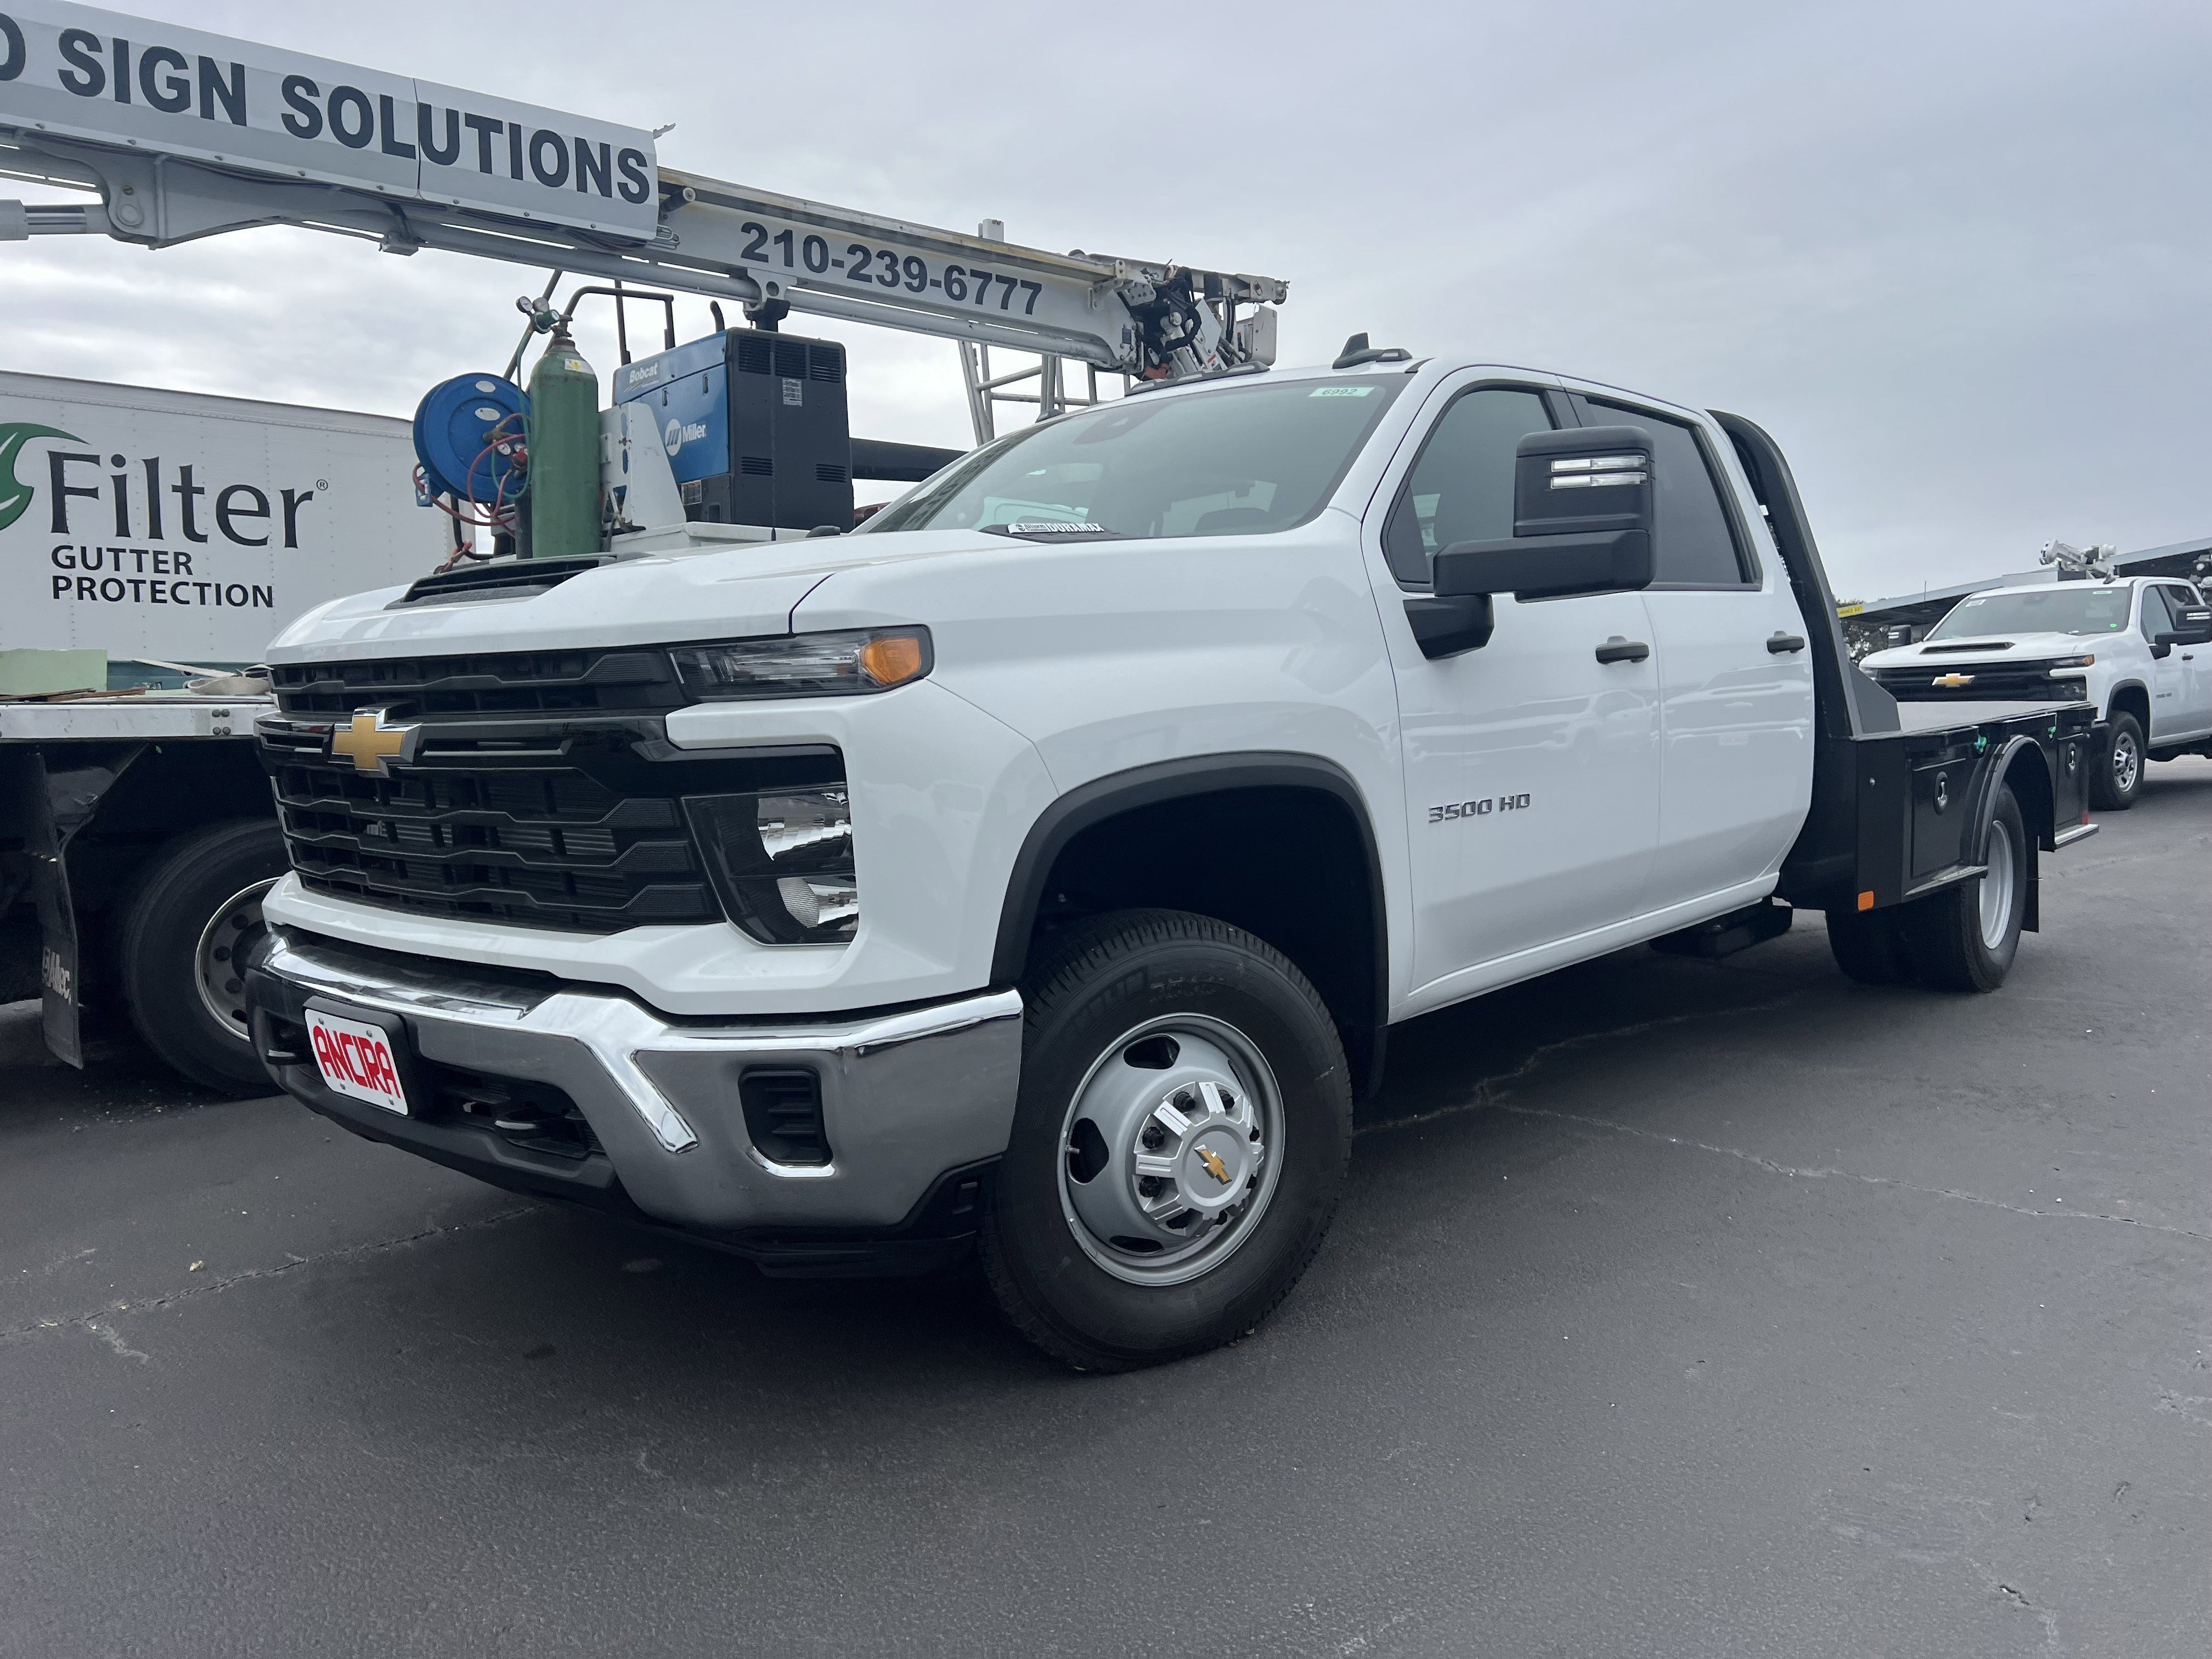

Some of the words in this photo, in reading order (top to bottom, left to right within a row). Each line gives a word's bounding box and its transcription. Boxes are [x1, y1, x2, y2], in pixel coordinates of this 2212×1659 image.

[58, 28, 247, 126] SIGN
[280, 74, 650, 204] SOLUTIONS
[741, 222, 1042, 315] 210-239-6777
[629, 363, 658, 383] Bobcat
[1047, 523, 1104, 532] DURAMAX
[52, 545, 193, 575] GUTTER
[52, 575, 274, 608] PROTECTION
[1429, 799, 1492, 823] 3500
[1499, 793, 1530, 812] HD
[313, 1025, 401, 1099] ANCIRA
